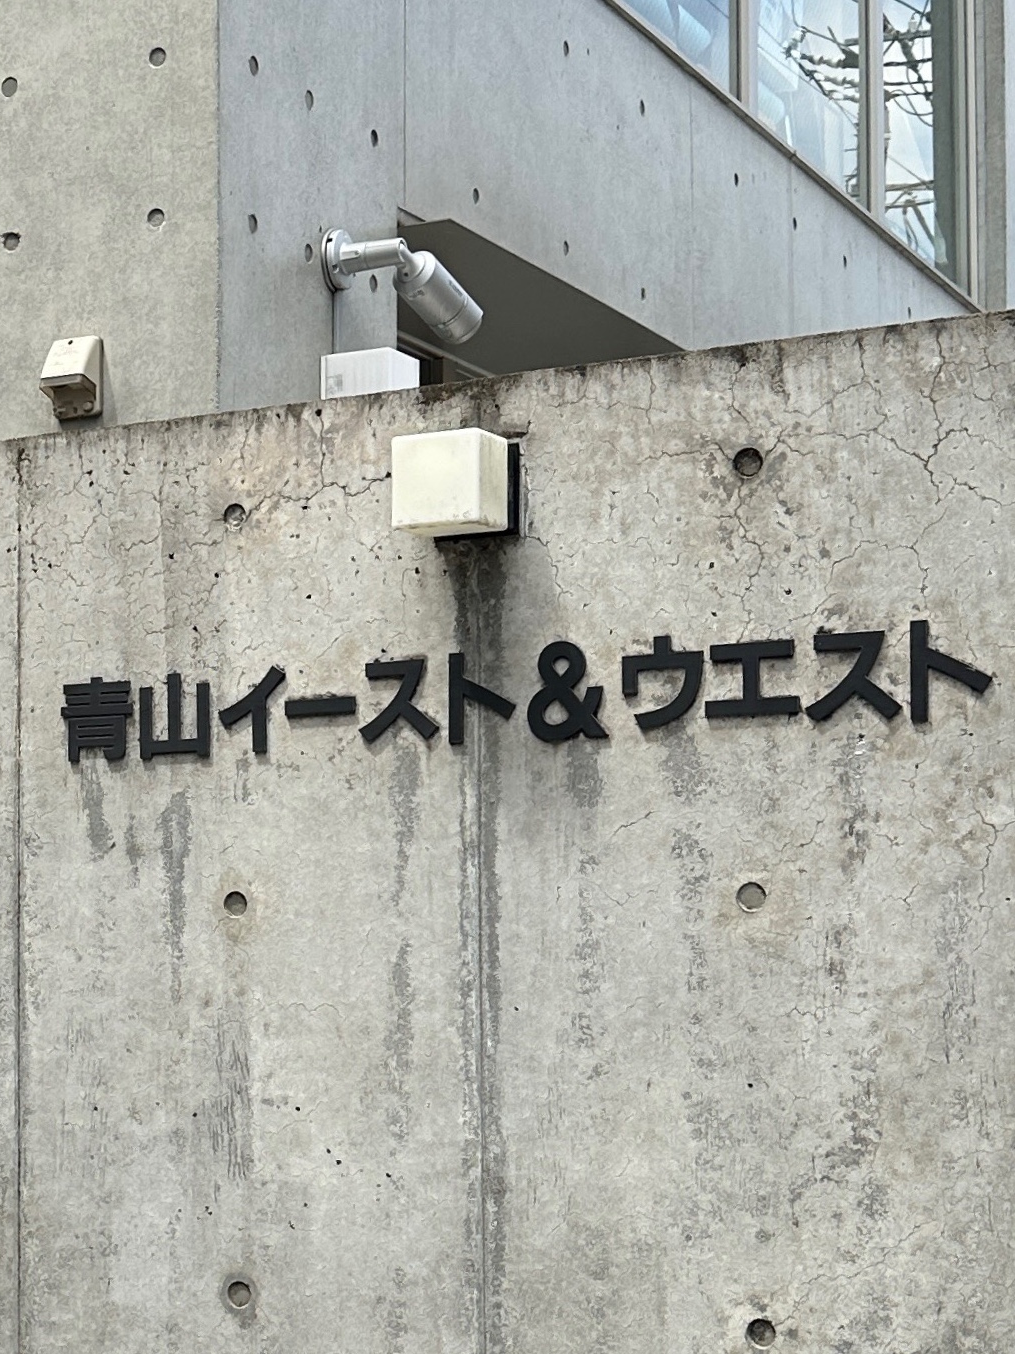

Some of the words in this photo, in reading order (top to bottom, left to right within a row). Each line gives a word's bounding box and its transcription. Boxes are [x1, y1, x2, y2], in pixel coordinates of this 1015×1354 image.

[60, 619, 993, 764] 青山イースト&ウエスト
